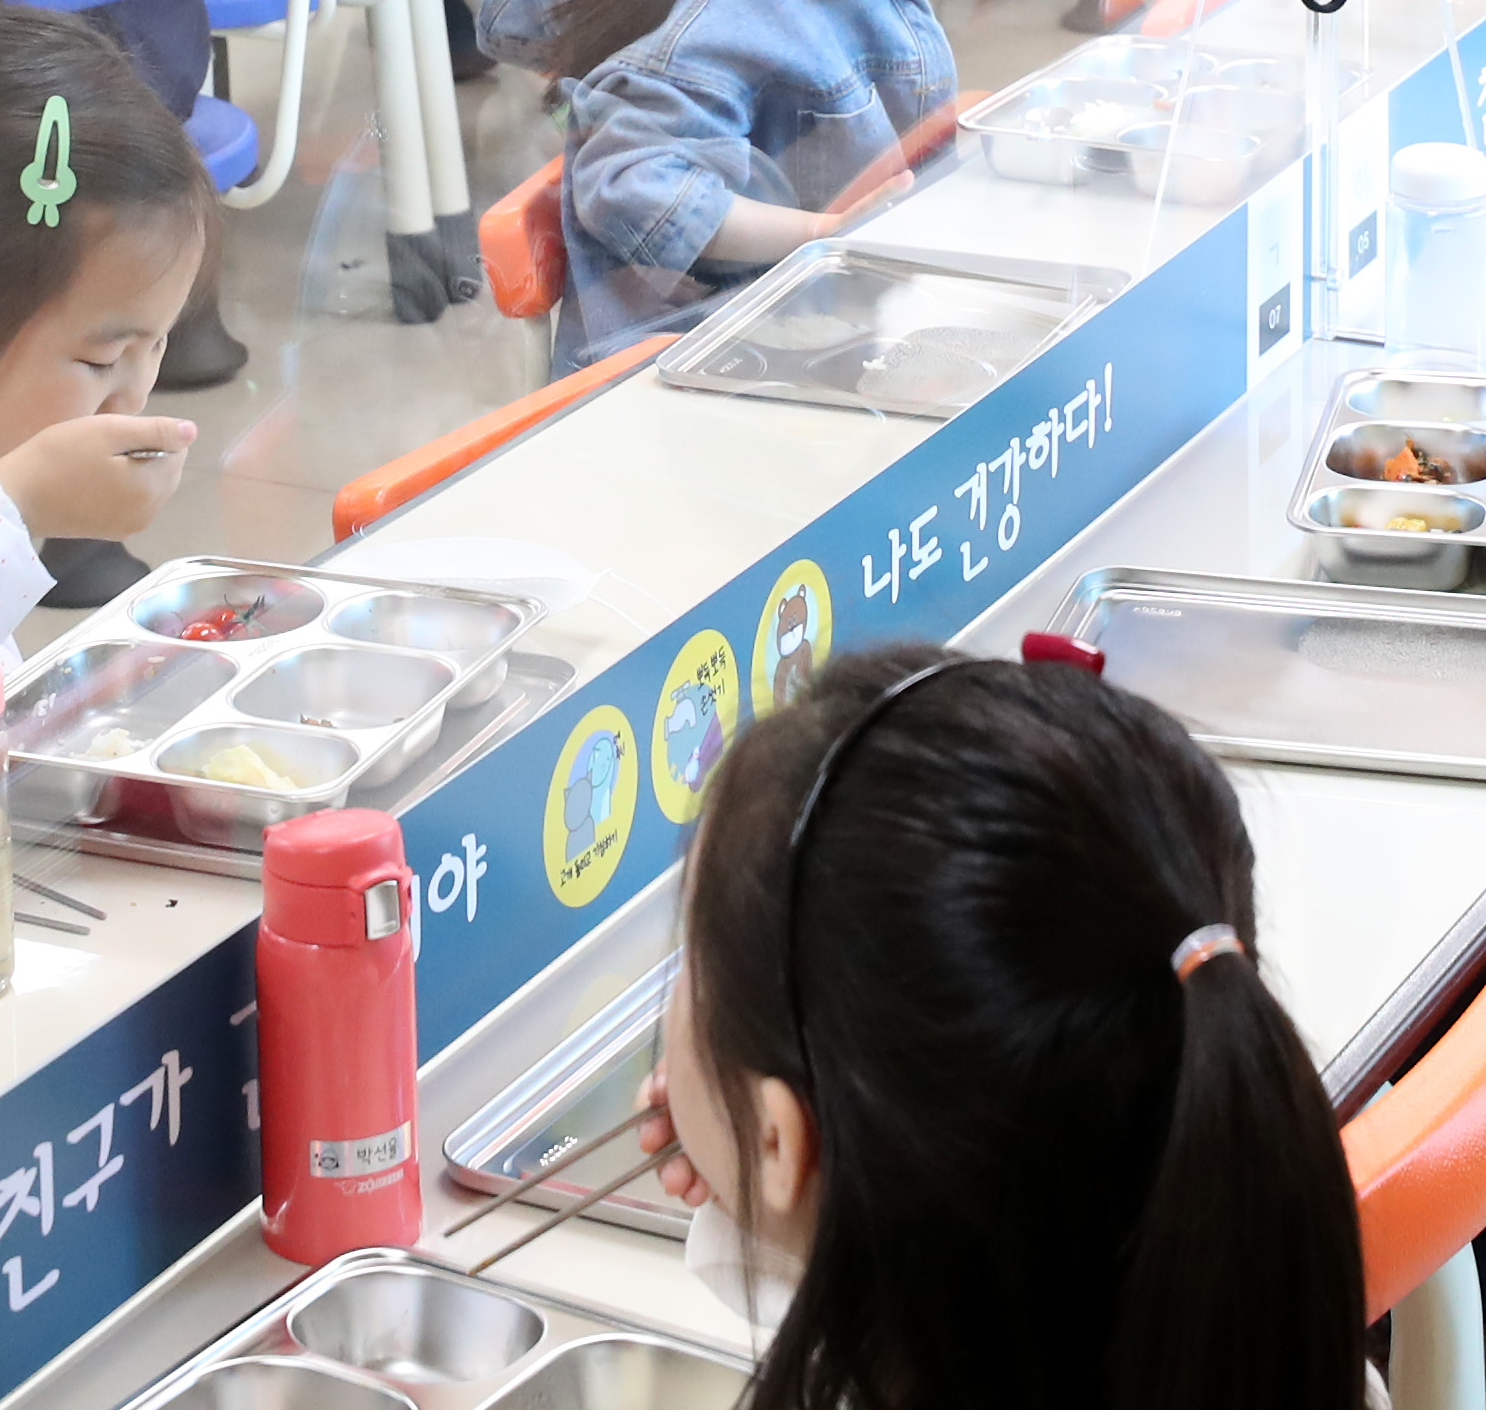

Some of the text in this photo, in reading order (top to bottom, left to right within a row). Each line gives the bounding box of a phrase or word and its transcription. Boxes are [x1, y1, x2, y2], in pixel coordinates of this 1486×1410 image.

[1267, 304, 1282, 331] 07
[861, 362, 1113, 604] 나도 건강하다!
[356, 1137, 398, 1165] 박선율
